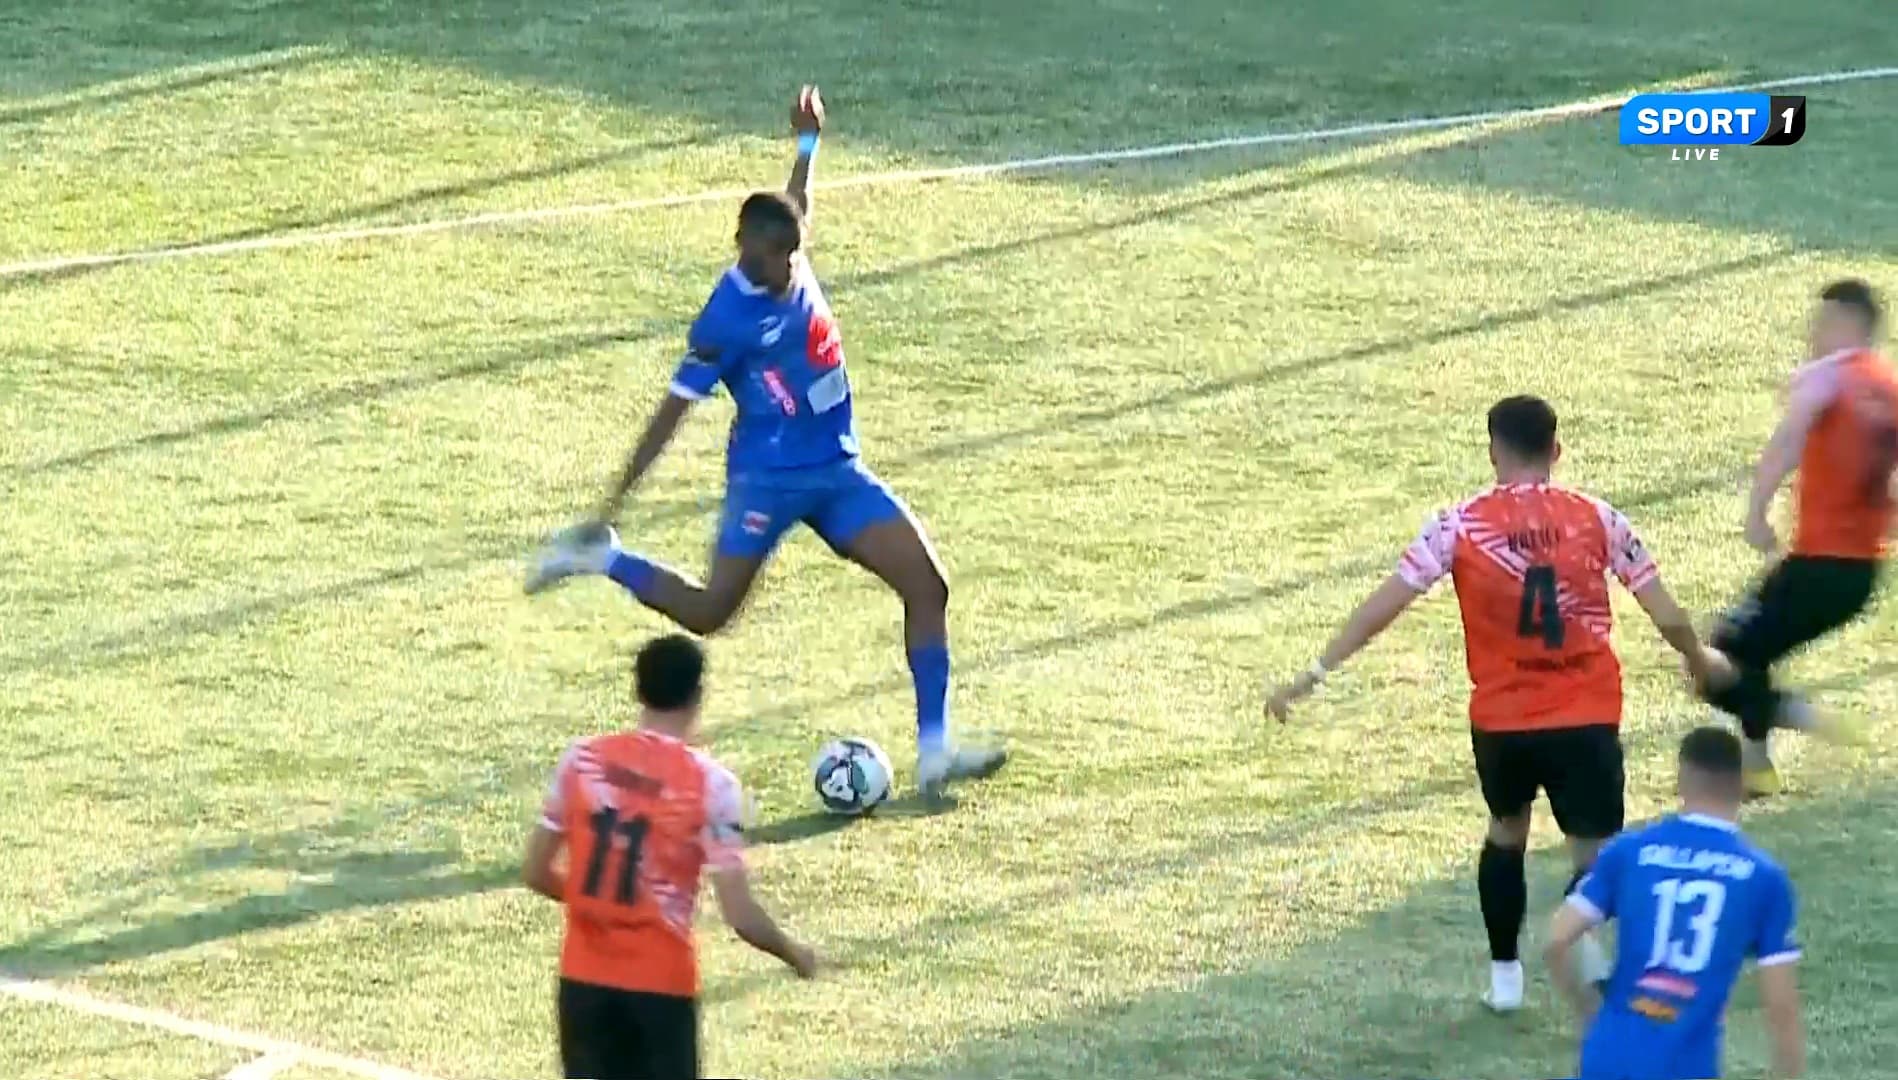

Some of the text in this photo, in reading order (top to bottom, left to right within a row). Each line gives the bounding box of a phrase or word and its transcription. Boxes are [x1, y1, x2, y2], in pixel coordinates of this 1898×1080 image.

[1517, 565, 1566, 650] 4
[581, 805, 652, 907] 11
[1644, 878, 1727, 973] 13
